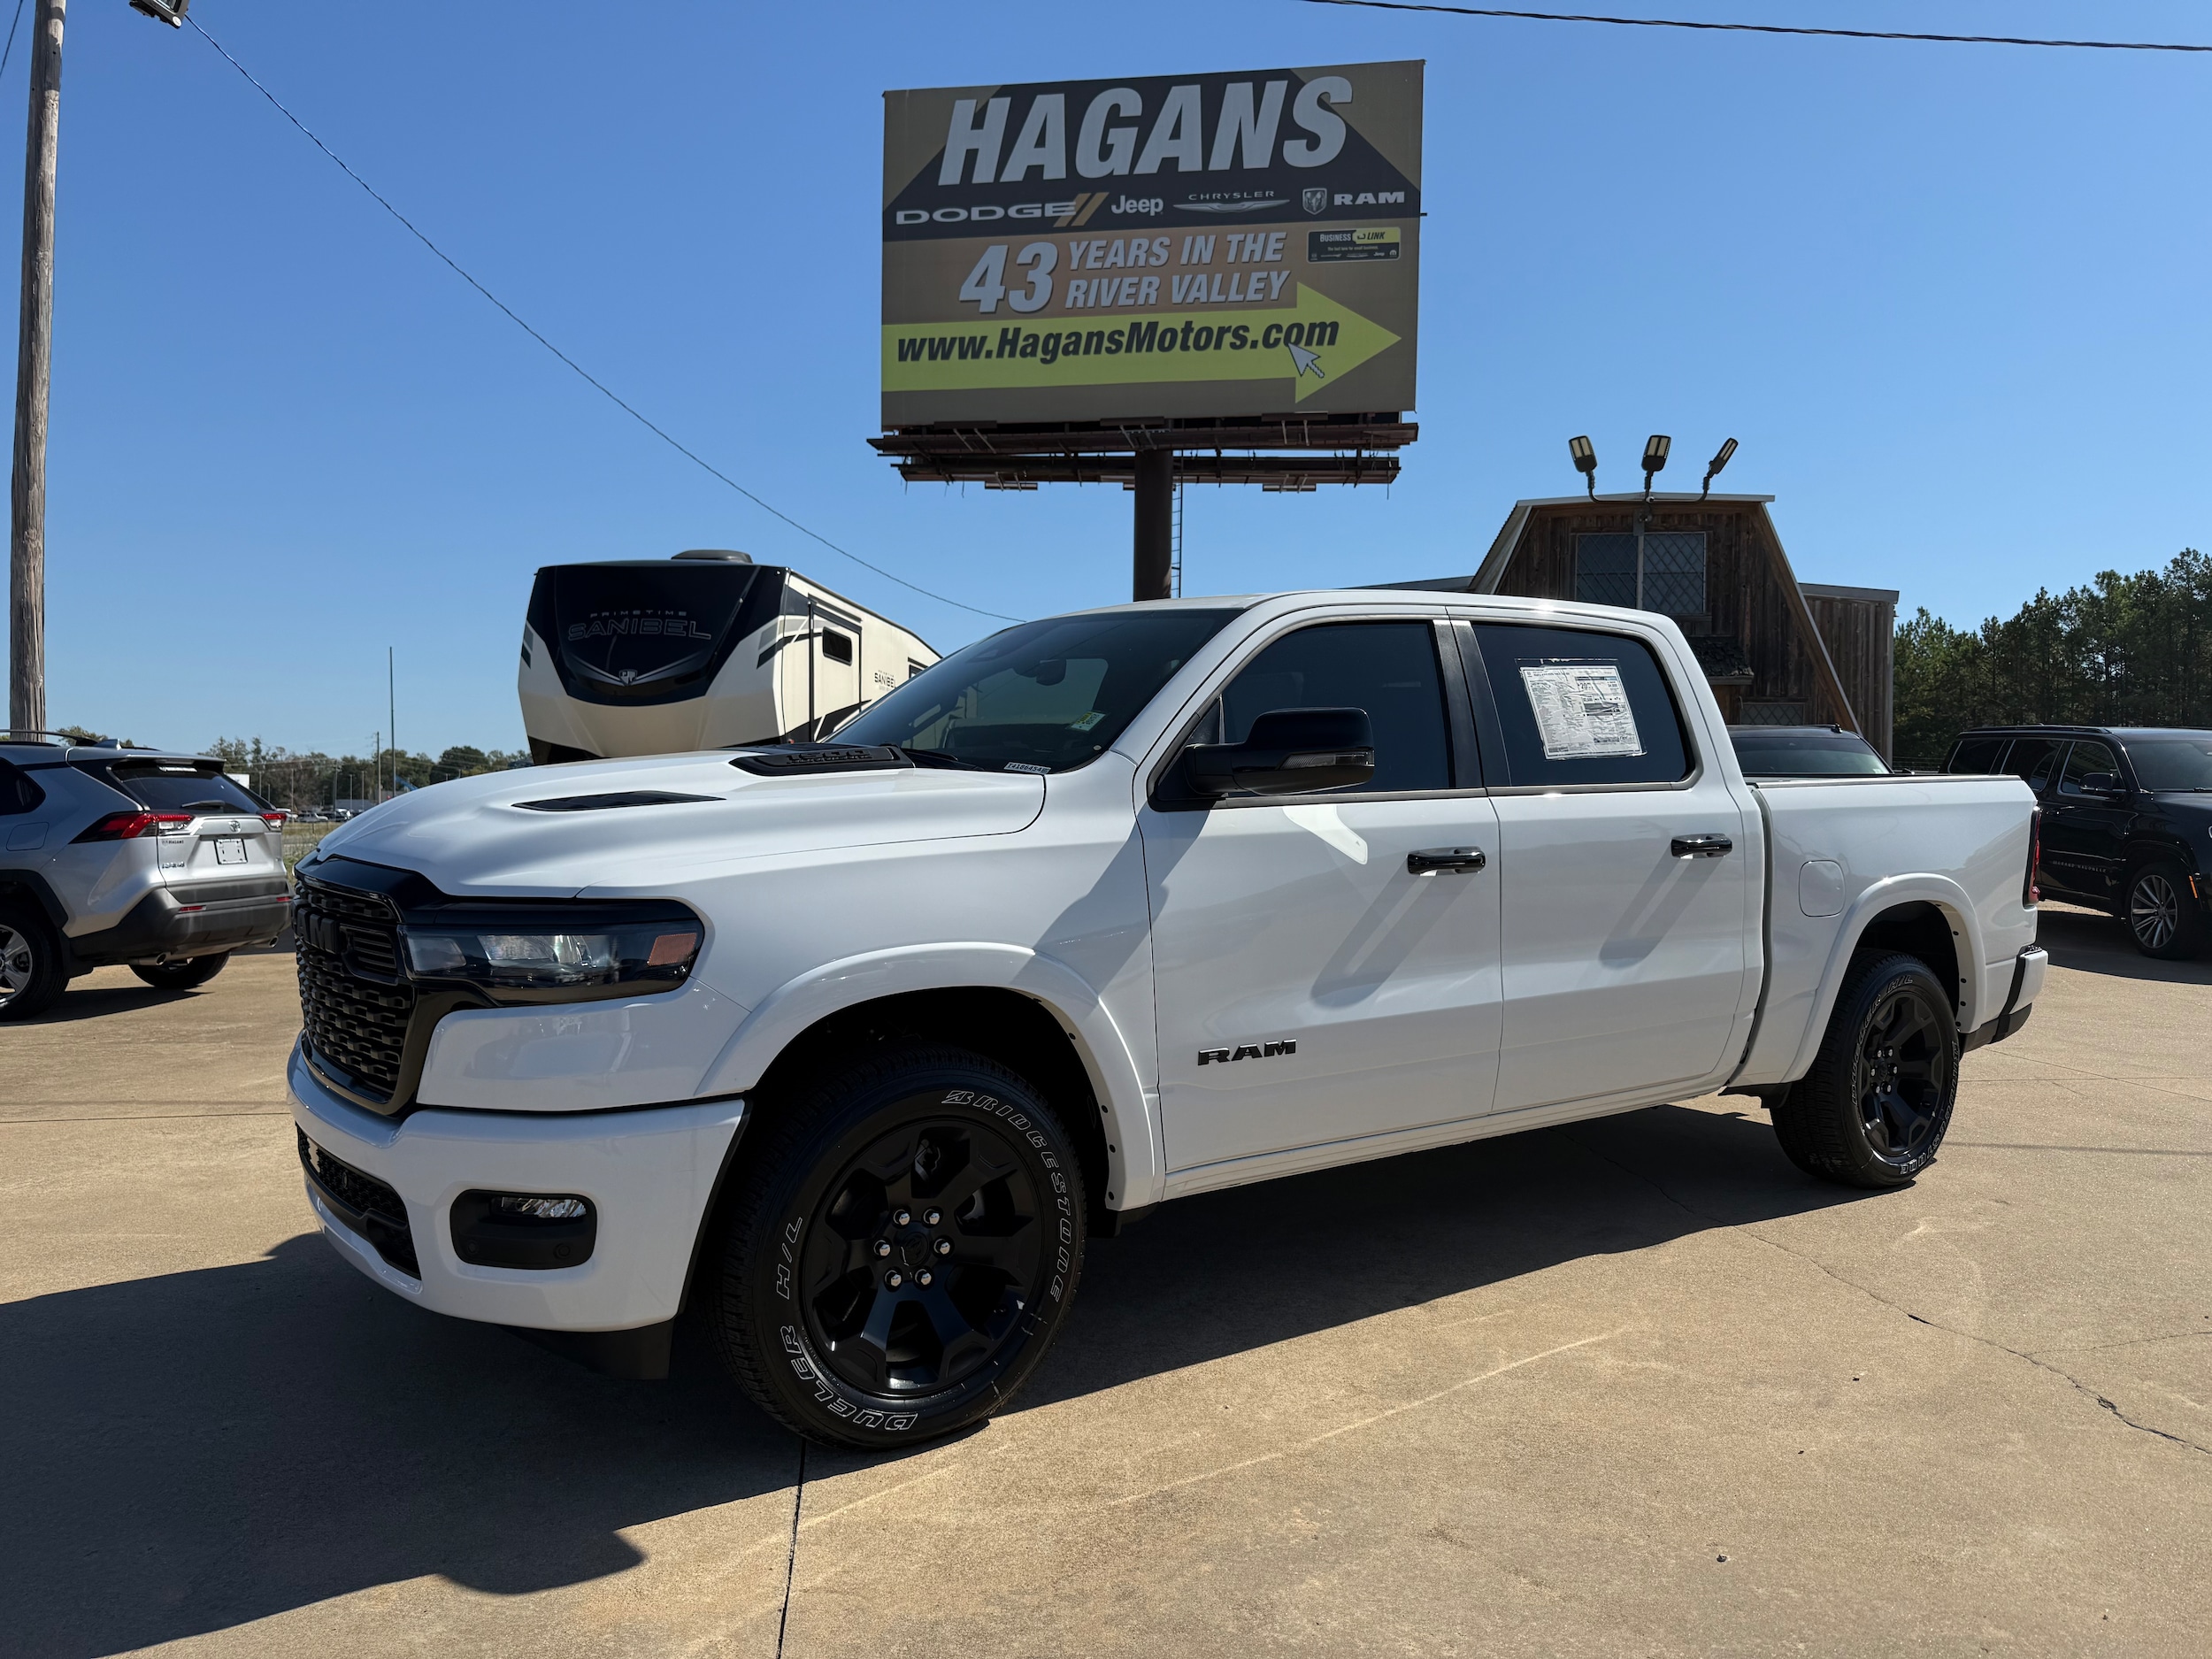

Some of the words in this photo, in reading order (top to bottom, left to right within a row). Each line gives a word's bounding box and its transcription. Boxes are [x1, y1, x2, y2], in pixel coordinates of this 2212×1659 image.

[938, 76, 1354, 187] HAGANS
[1110, 195, 1164, 217] Jeep
[1187, 190, 1275, 202] CHRYSLER
[1333, 191, 1405, 206] RAM
[895, 202, 1077, 226] DODGE
[1319, 234, 1352, 242] BUSINESS
[959, 240, 1059, 313] 43
[1068, 237, 1170, 271] YEARS
[1180, 234, 1217, 265] IN
[1226, 231, 1287, 264] THE
[1064, 274, 1160, 309] RIVER
[1171, 270, 1291, 304] VALLEY
[897, 319, 1340, 365] www.HagansMotors.com
[567, 618, 712, 641] SANIBEL
[1197, 1039, 1297, 1066] RAM
[941, 1090, 1072, 1303] BRIDGESTONE
[780, 1325, 919, 1431] DUELER
